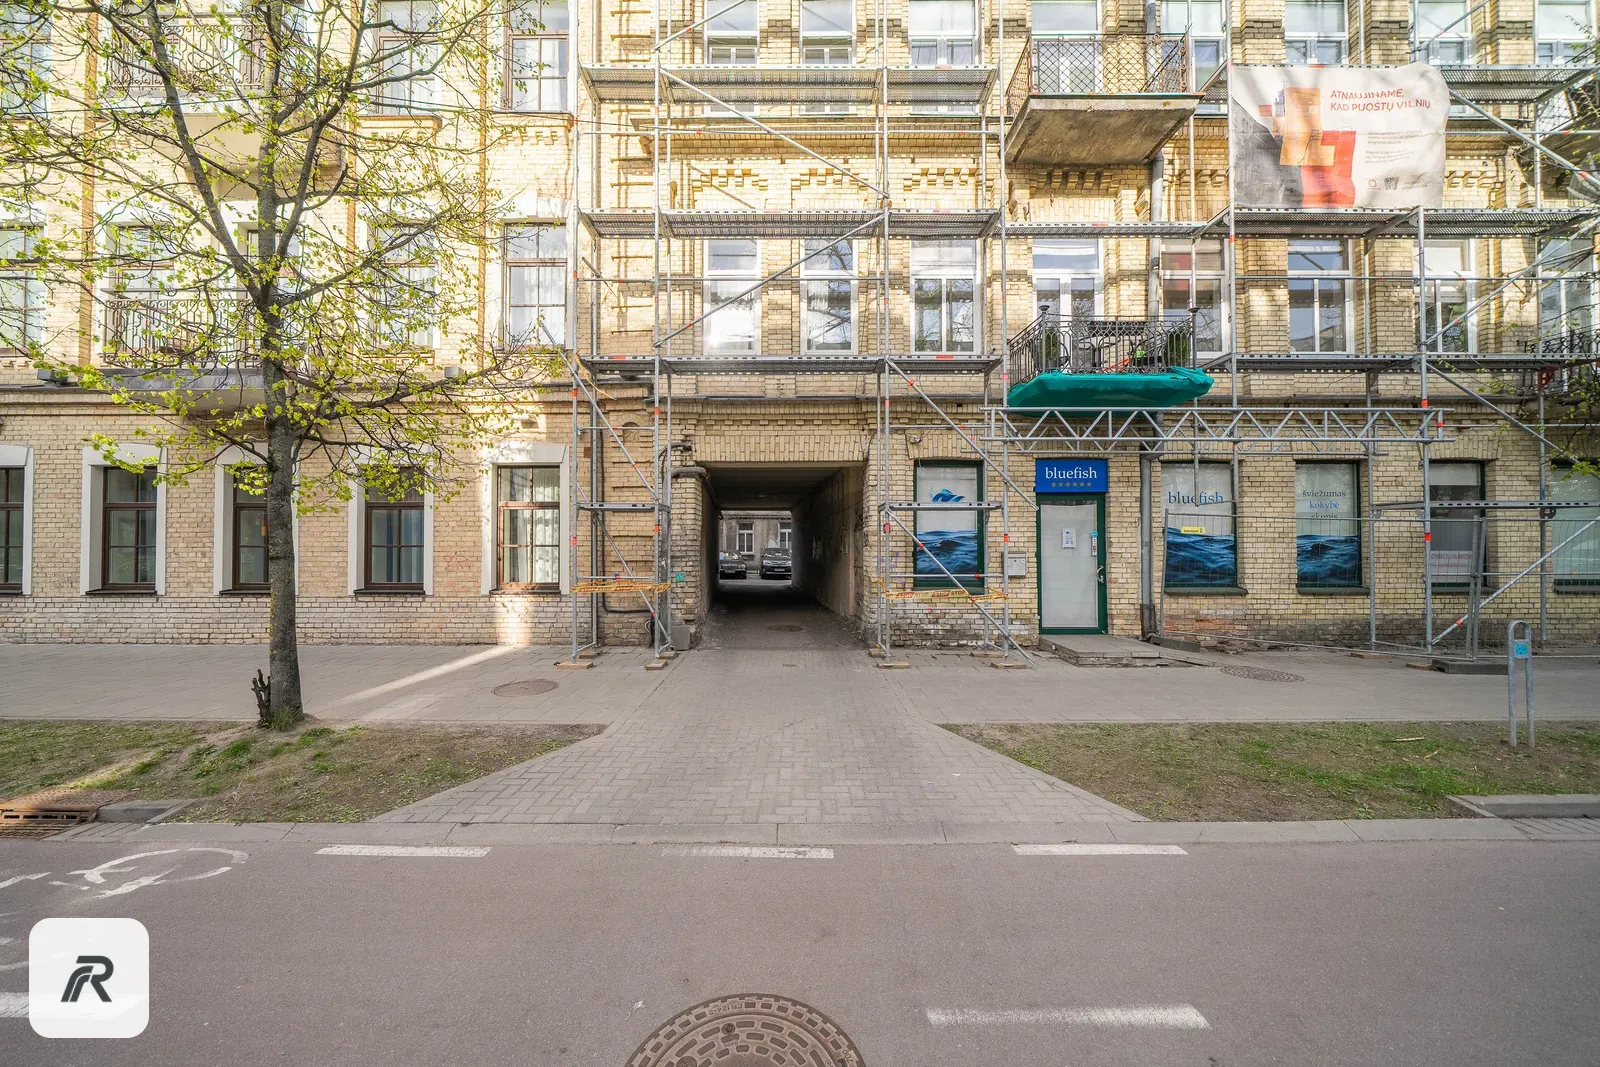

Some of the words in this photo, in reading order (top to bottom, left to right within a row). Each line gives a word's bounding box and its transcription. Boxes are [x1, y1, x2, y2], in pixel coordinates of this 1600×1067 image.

[1330, 102, 1350, 111] KAD
[1396, 99, 1431, 109] VILNIŲ
[1045, 467, 1097, 479] bluefish
[1168, 491, 1224, 504] bluefish
[1302, 490, 1346, 498] šviežumas
[1309, 500, 1340, 511] kokybė
